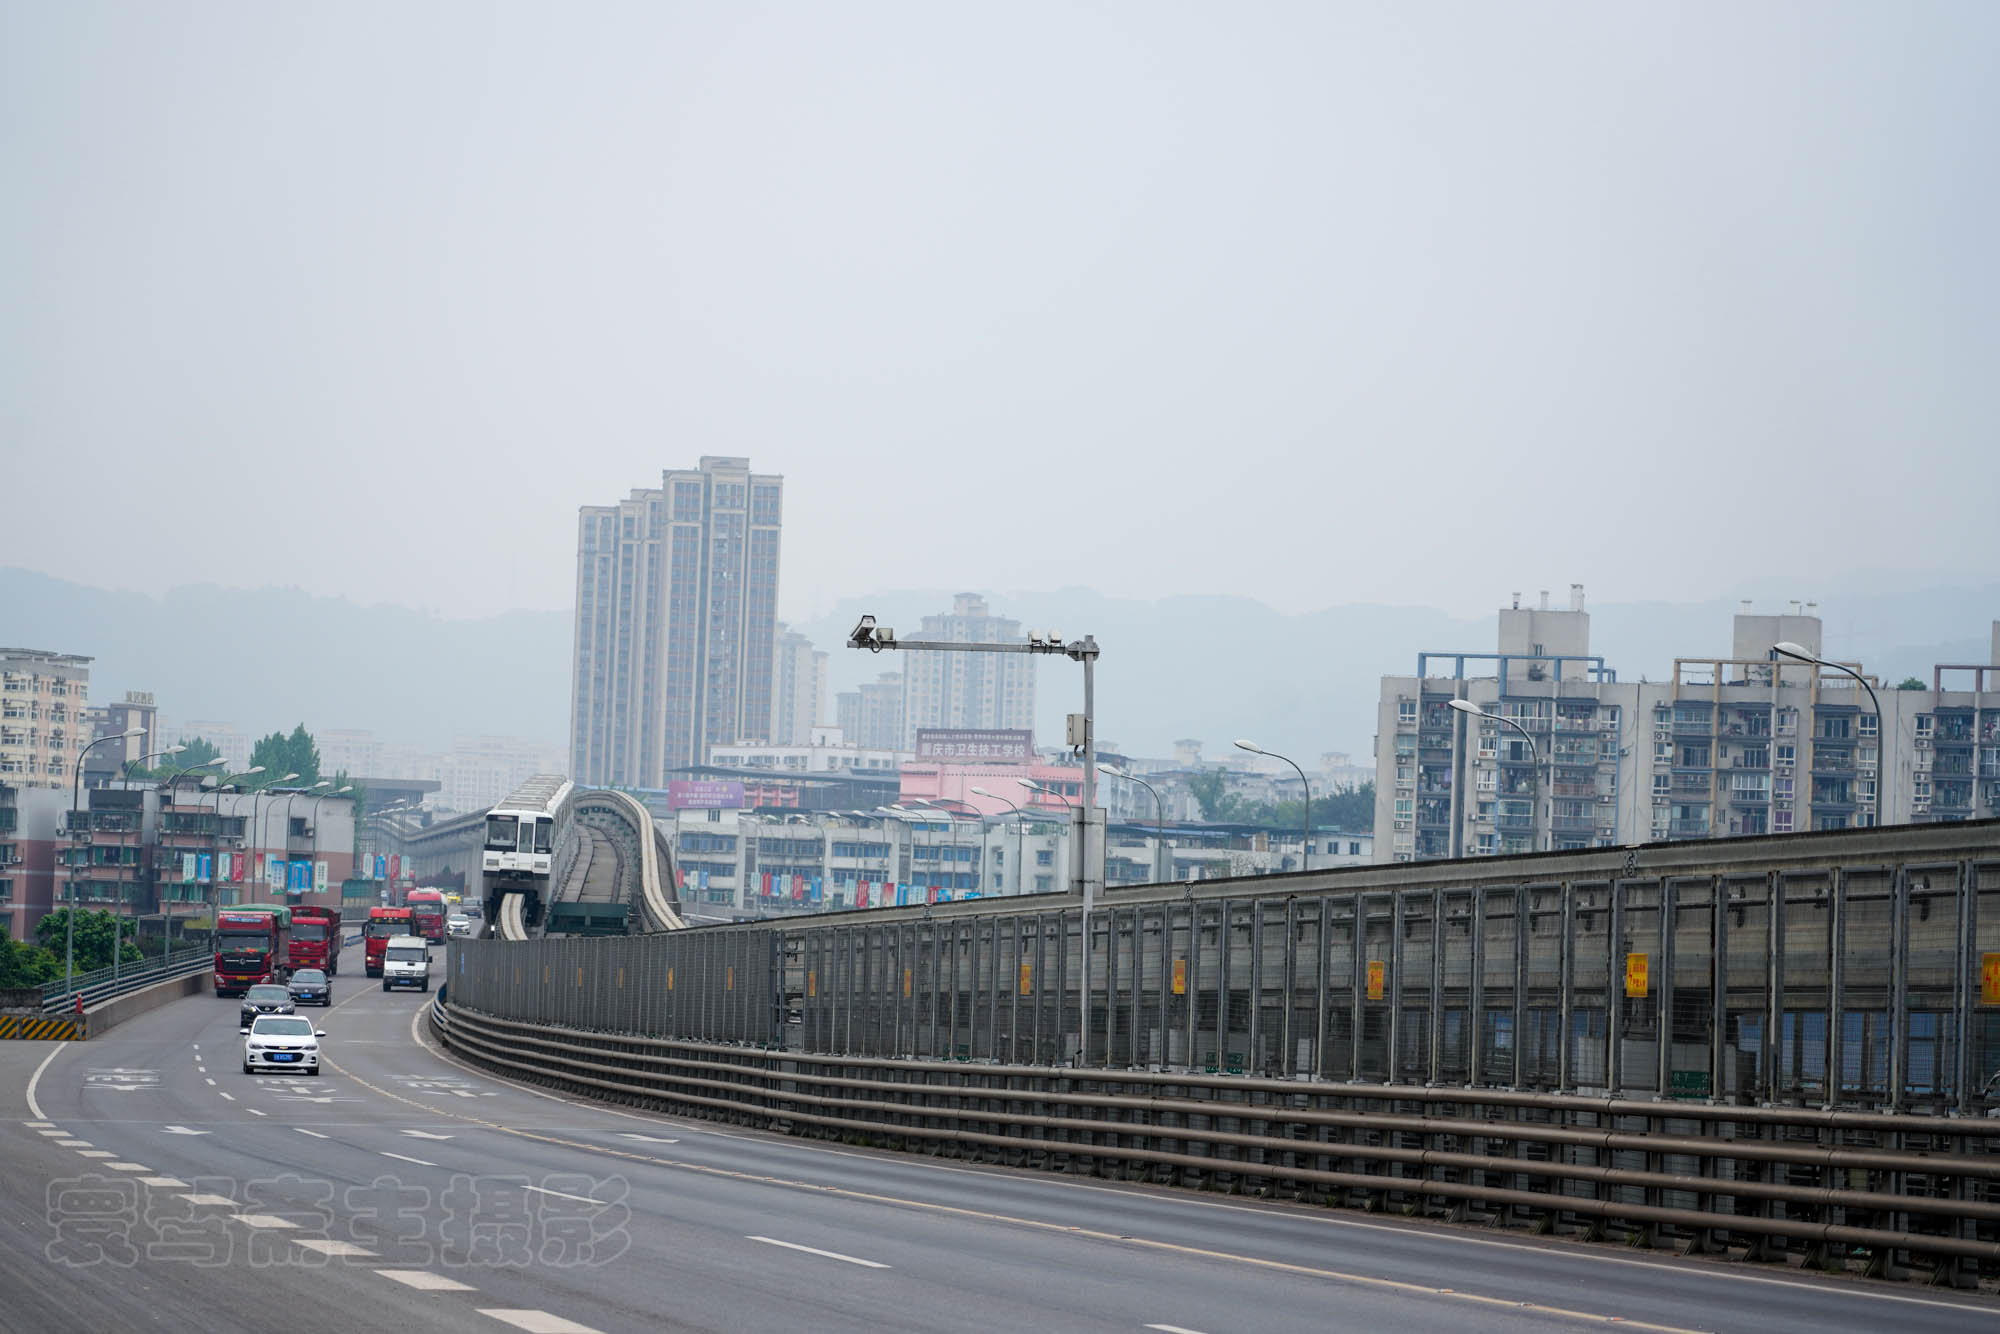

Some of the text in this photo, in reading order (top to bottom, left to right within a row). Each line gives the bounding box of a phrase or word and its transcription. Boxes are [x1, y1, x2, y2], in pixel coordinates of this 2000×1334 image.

[921, 743, 1025, 758] 重庆市卫生技工学校
